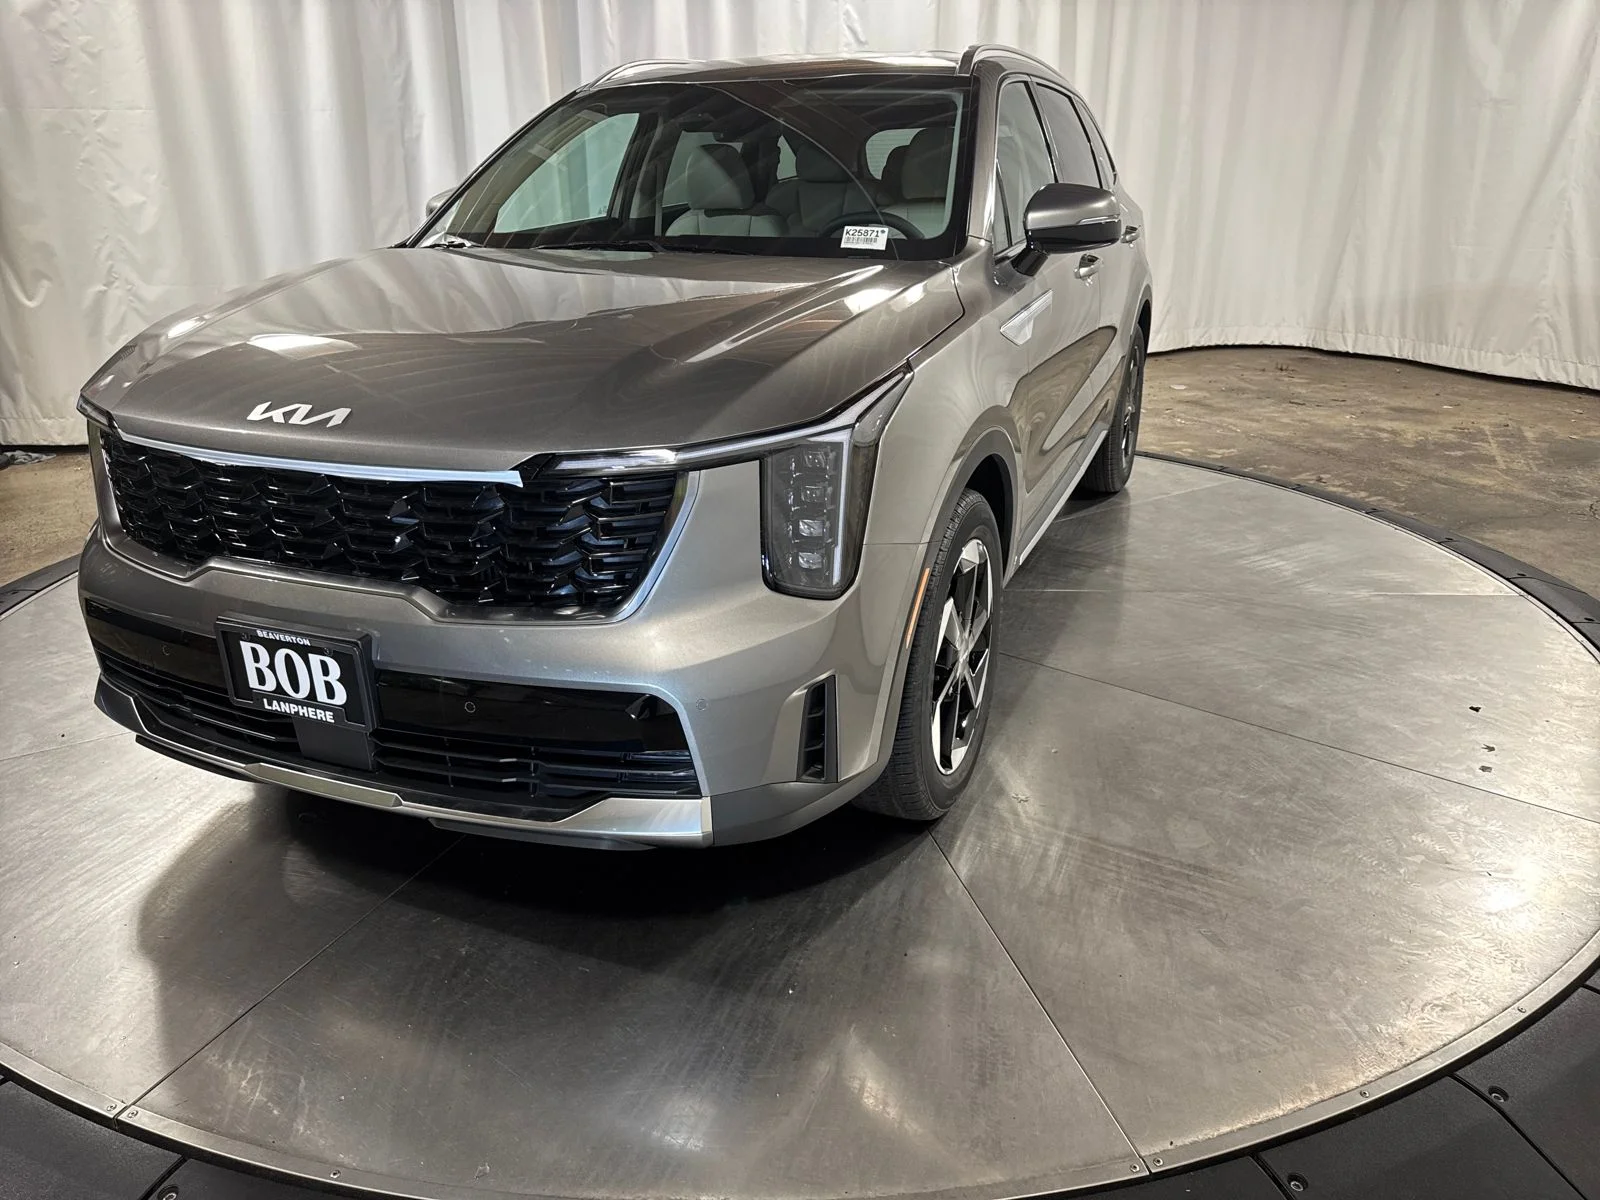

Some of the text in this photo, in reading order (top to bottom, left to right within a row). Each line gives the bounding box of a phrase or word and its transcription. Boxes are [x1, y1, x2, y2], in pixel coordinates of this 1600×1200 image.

[845, 229, 879, 238] K25871
[246, 401, 352, 428] KIA
[256, 629, 311, 646] BEAVERTON
[239, 640, 348, 706] BOB
[263, 698, 335, 723] LANPHERE
